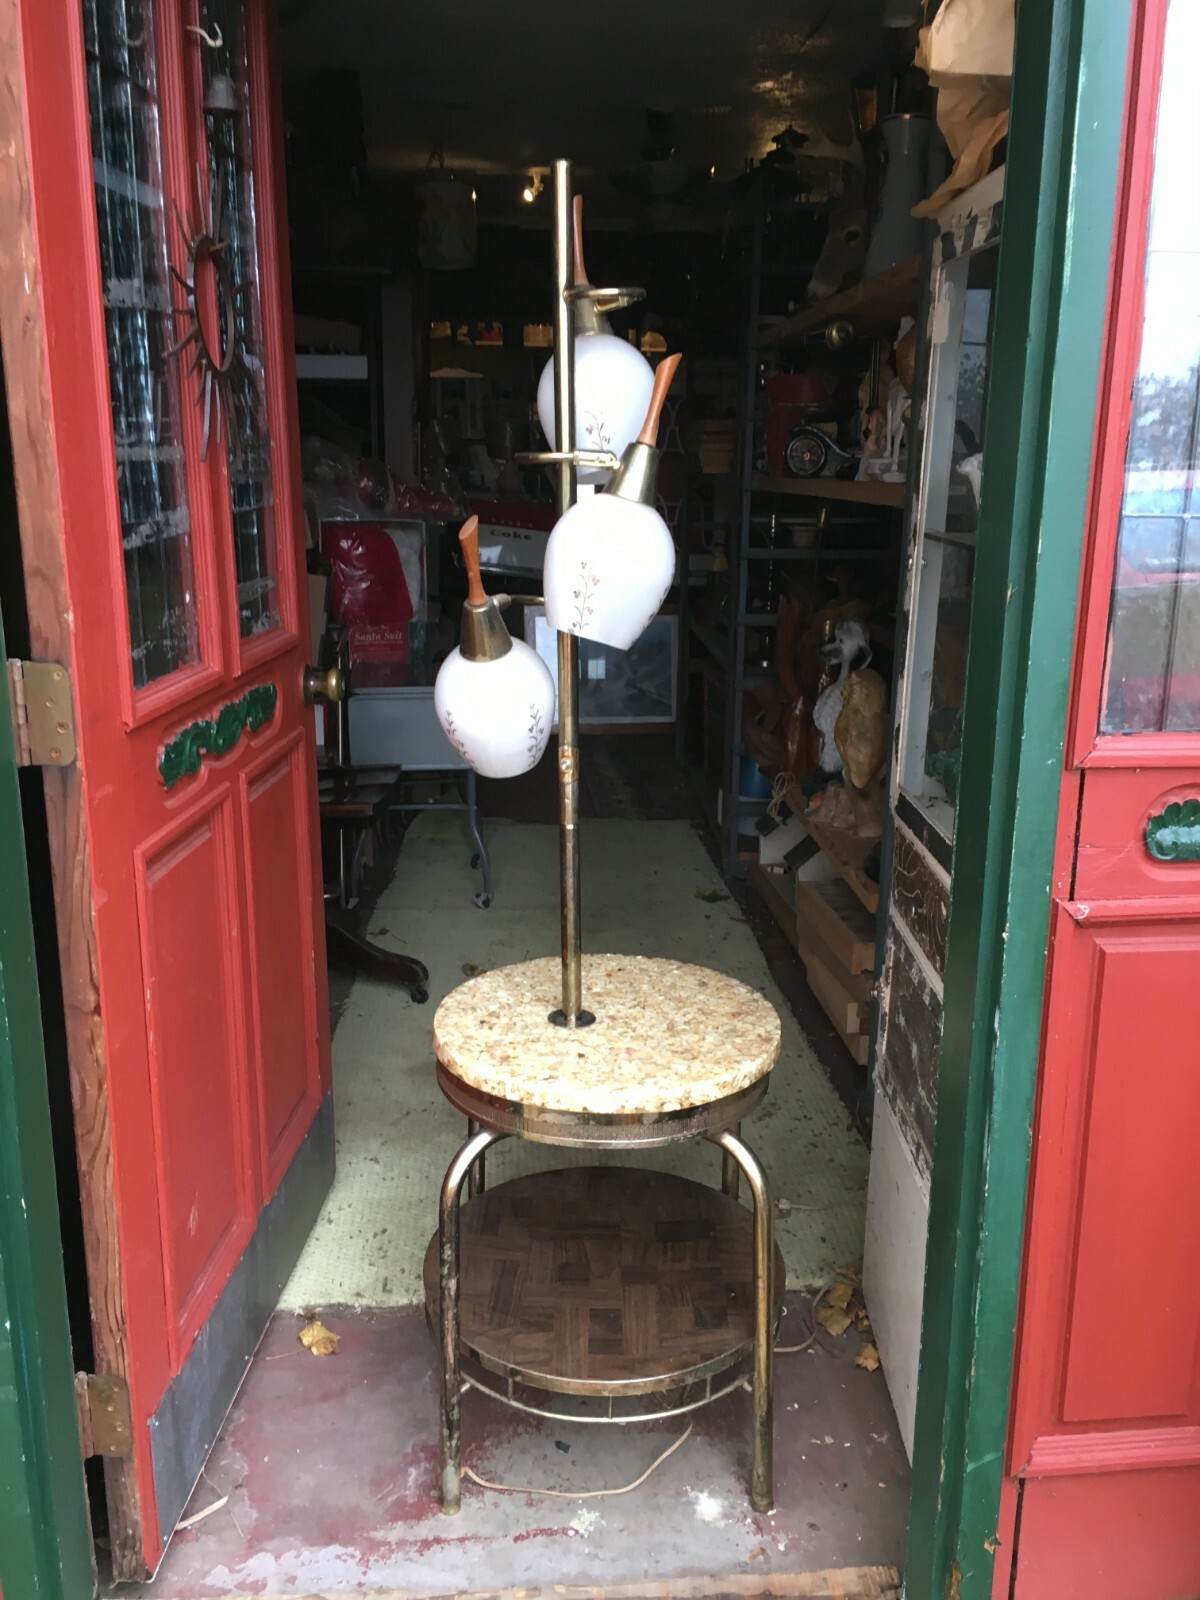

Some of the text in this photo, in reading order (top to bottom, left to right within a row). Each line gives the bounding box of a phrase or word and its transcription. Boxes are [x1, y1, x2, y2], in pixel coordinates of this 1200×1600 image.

[489, 529, 533, 541] Coke
[354, 630, 403, 641] Santa Suit
